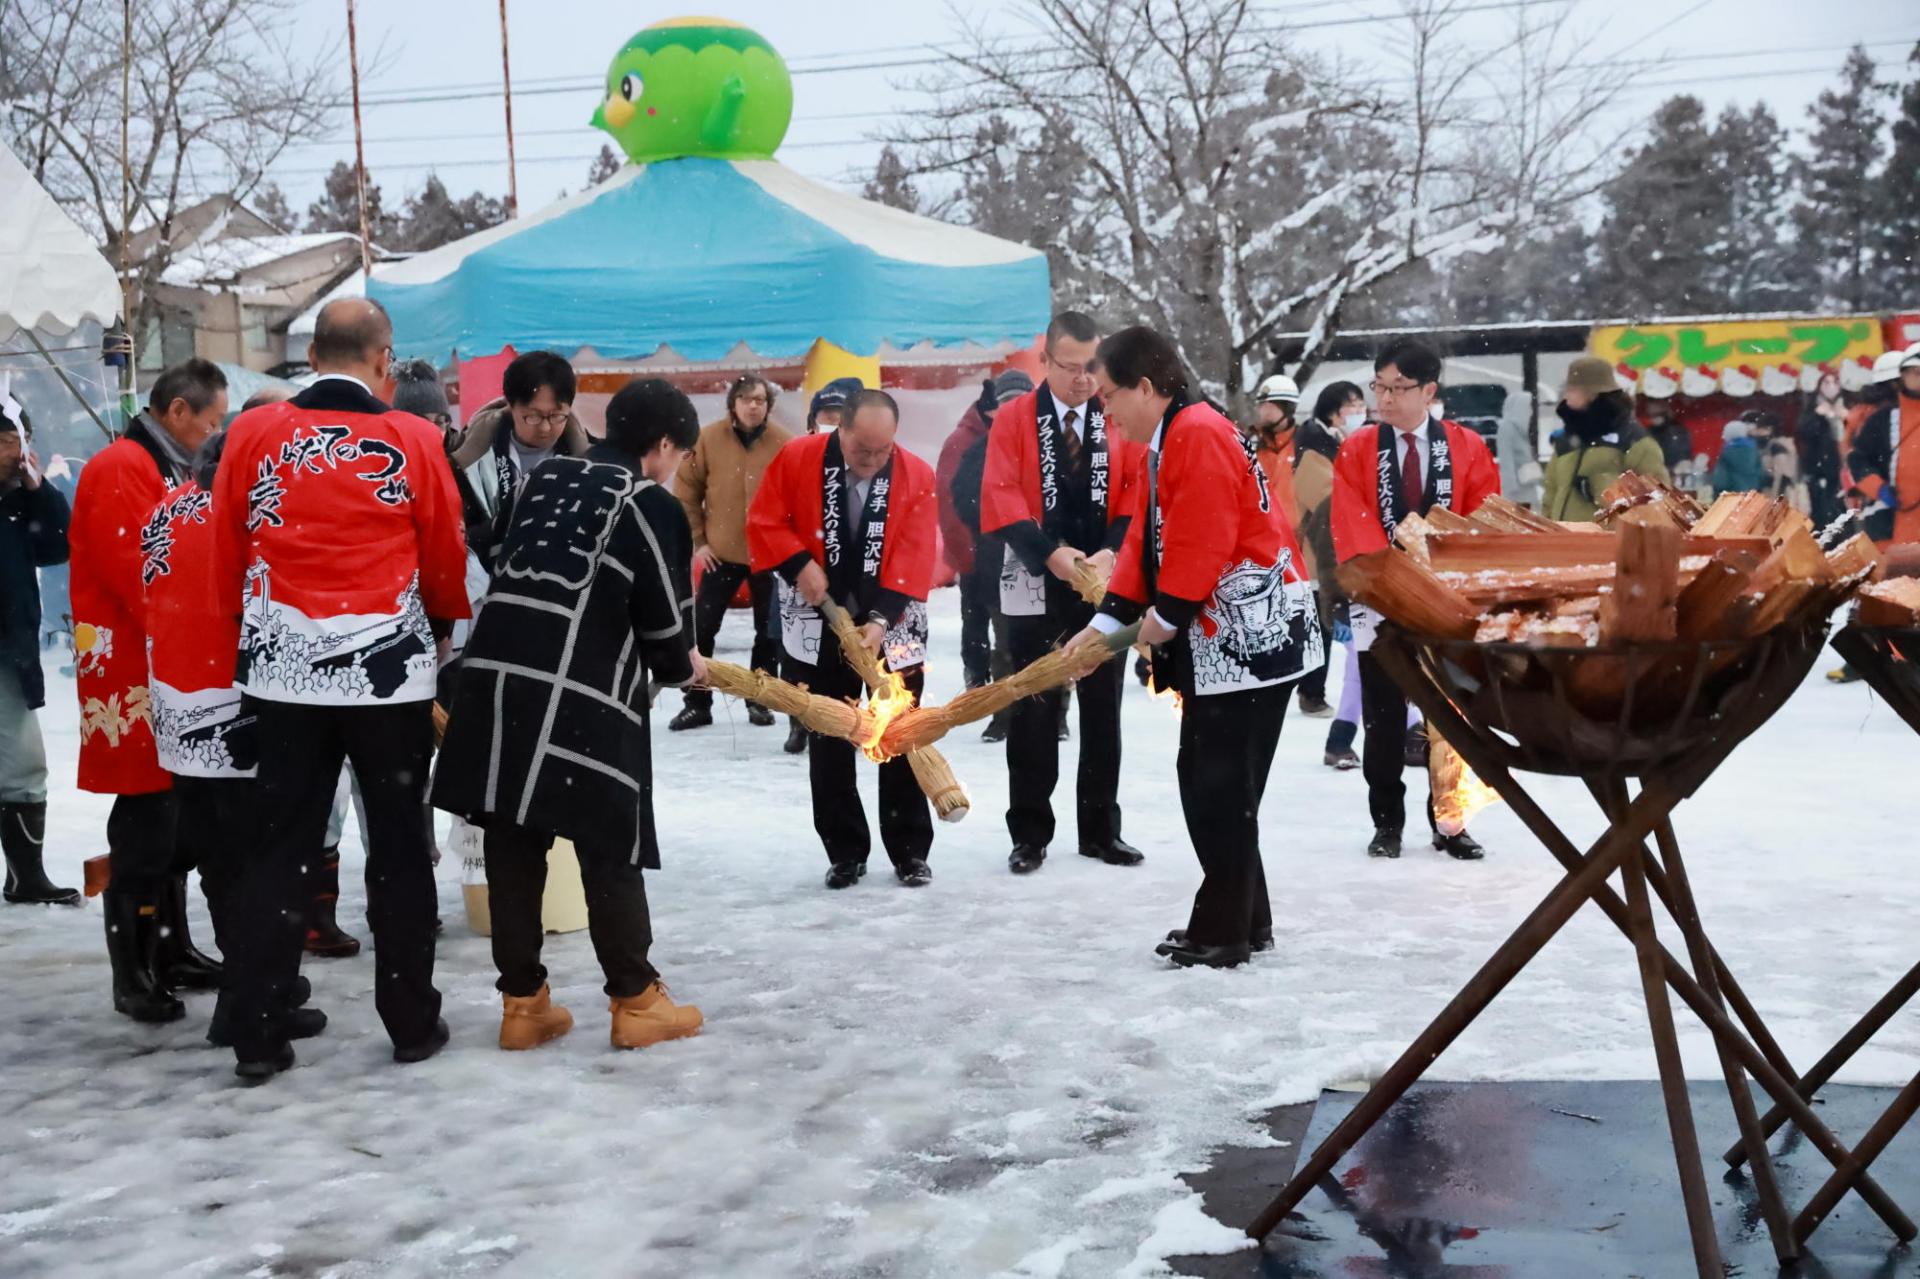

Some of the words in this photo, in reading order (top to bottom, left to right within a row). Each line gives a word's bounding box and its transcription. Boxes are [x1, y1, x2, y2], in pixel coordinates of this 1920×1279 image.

[1614, 322, 1870, 367] クレープ
[1090, 411, 1106, 443] 岩手
[1037, 413, 1058, 511] ワラと火のまつり
[1090, 452, 1109, 506] 胆沢町
[1431, 440, 1450, 472] 岩手
[823, 466, 841, 567] ワラと火のまつり
[869, 478, 889, 513] 岩手
[863, 521, 885, 577] 胆沢町
